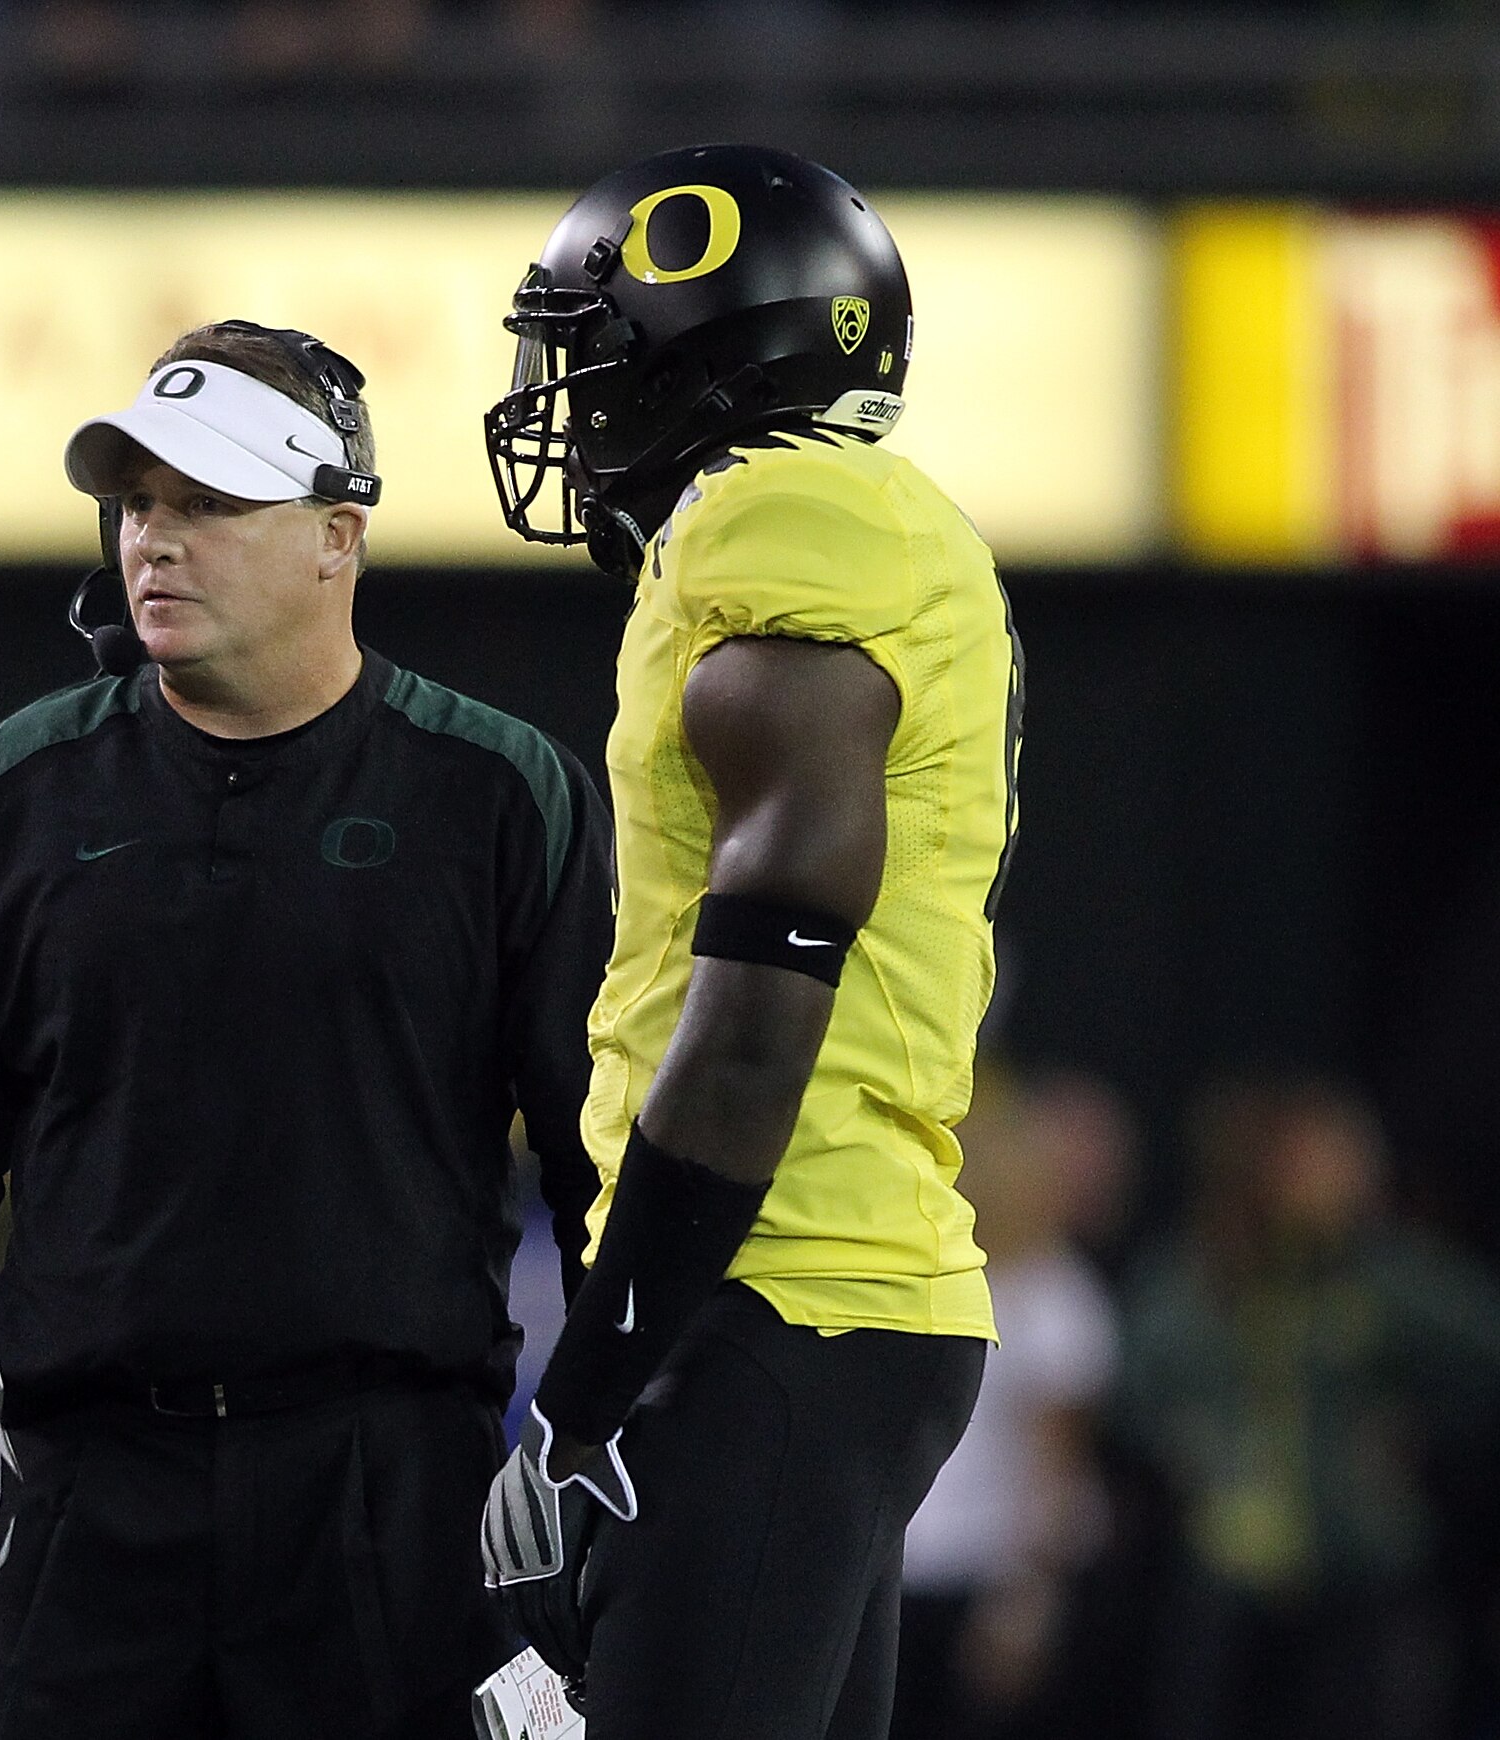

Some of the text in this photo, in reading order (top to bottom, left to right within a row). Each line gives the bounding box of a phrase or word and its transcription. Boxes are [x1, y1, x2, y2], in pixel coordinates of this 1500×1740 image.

[620, 185, 741, 284] O
[879, 351, 893, 374] 10
[153, 367, 206, 399] O
[857, 396, 901, 420] schutt
[347, 477, 373, 494] AT&T
